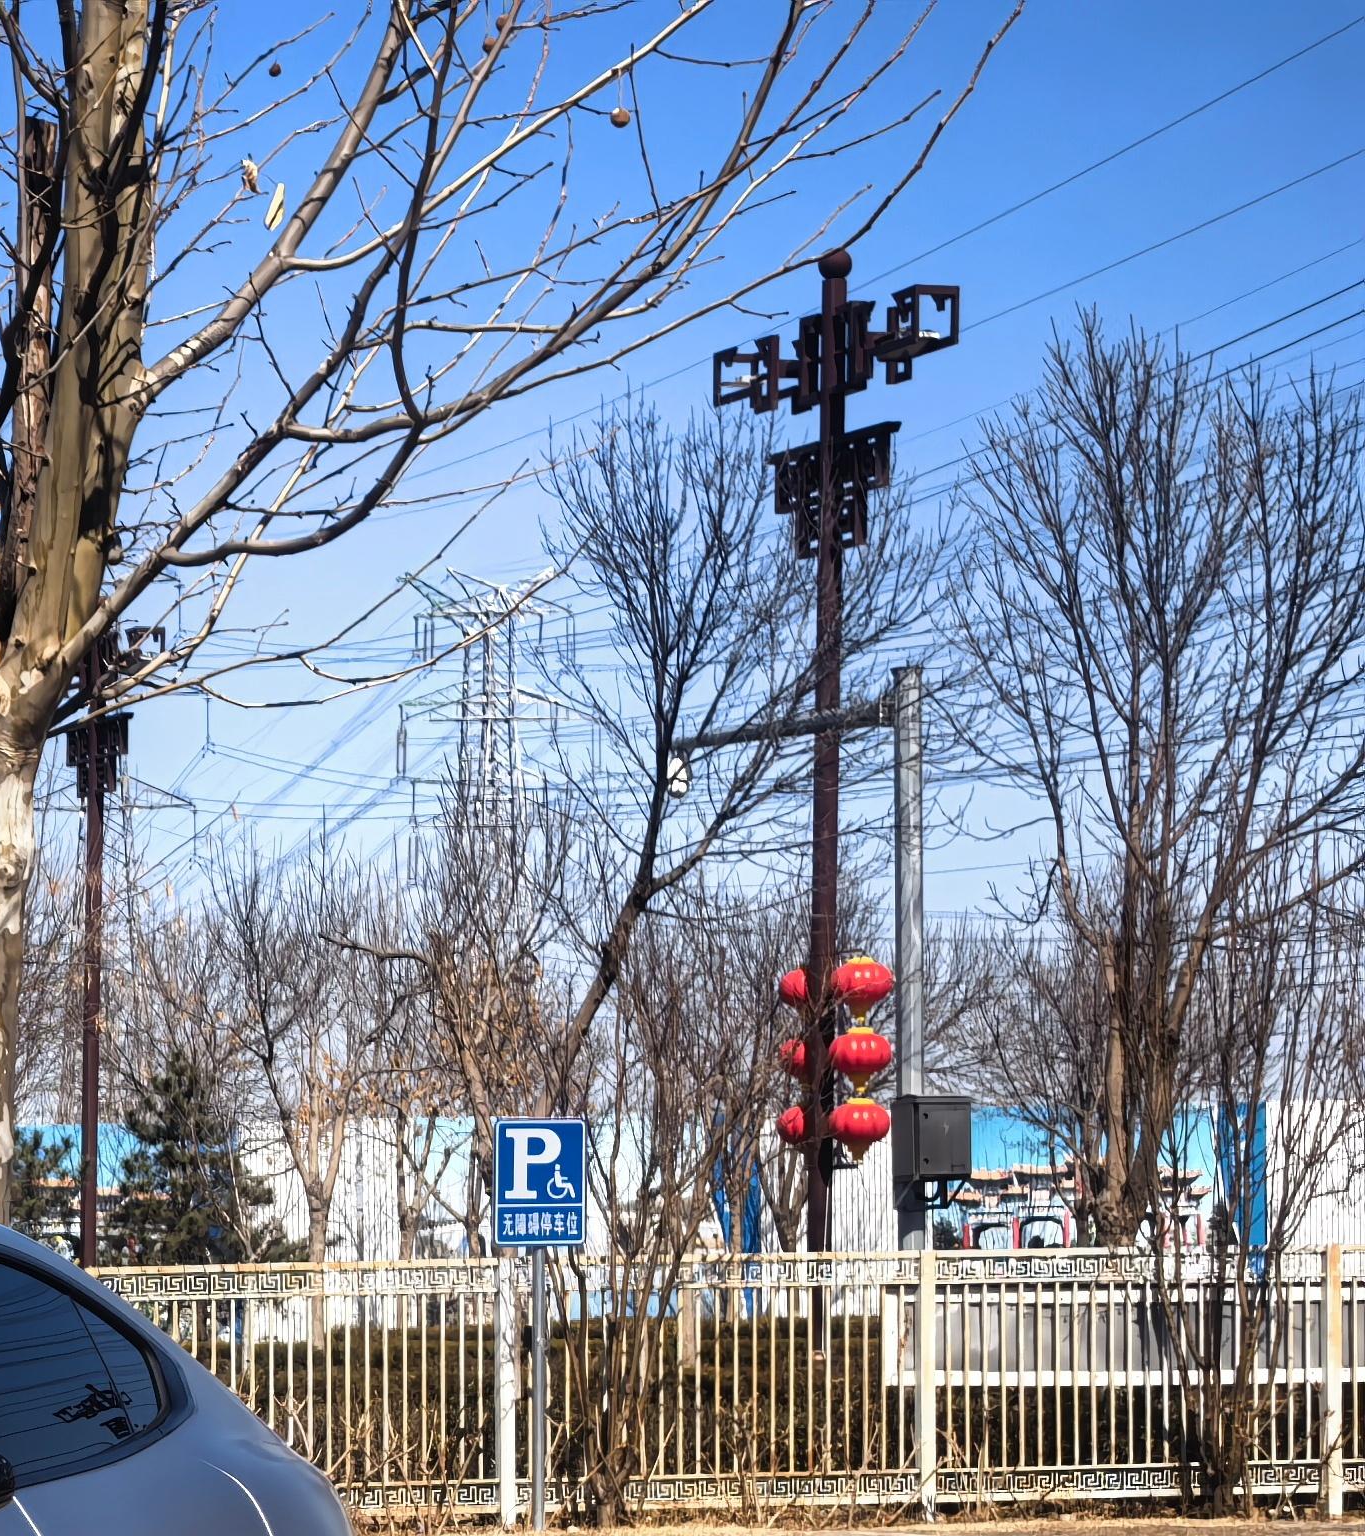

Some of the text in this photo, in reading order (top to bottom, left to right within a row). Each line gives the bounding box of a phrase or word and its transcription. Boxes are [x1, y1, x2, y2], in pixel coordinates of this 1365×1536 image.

[504, 1128, 562, 1199] P
[502, 1211, 579, 1237] 无障碍停车位
